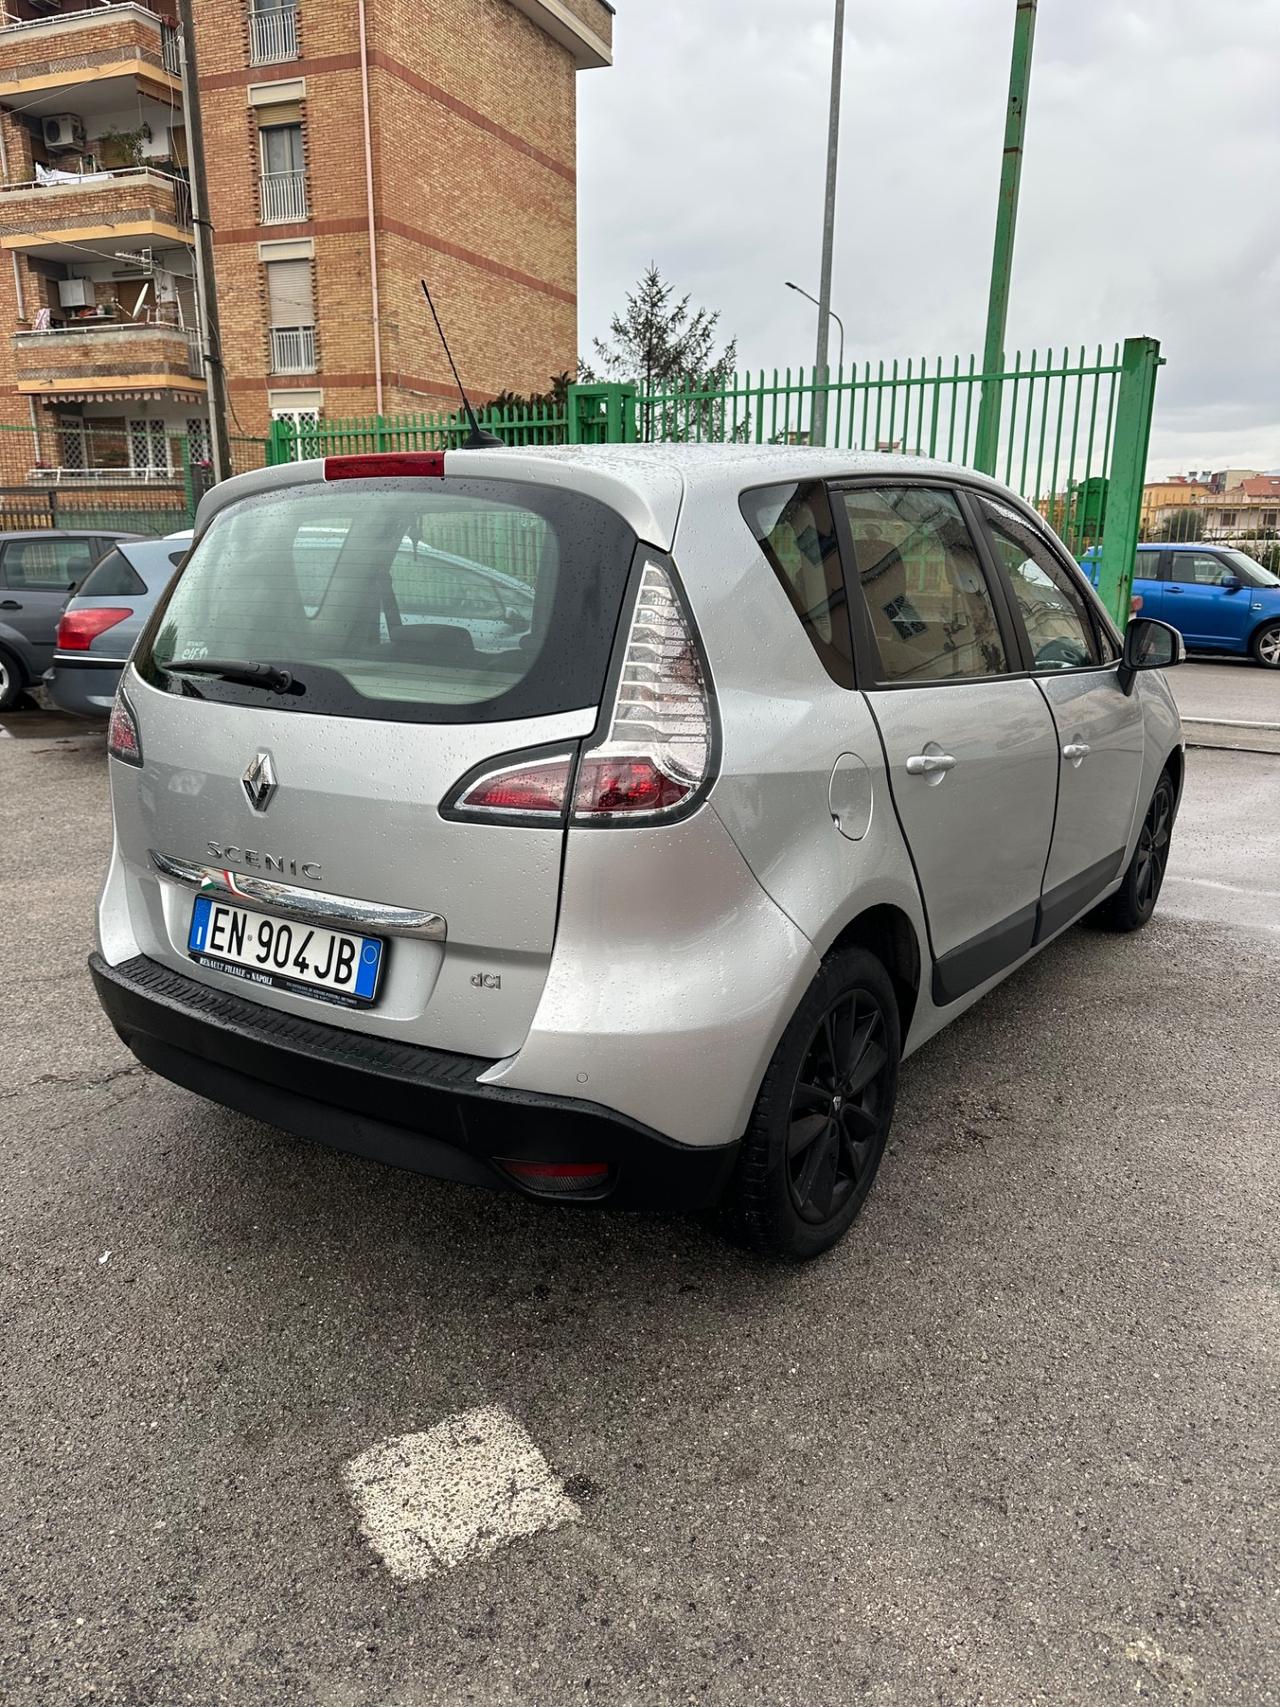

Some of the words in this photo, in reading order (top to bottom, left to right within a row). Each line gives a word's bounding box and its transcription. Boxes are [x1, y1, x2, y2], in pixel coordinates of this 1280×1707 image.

[207, 840, 323, 881] SCENIC
[210, 907, 248, 956] EN
[256, 919, 356, 984] 904JB
[199, 957, 224, 971] RENAULT
[251, 972, 274, 986] NAPOLI
